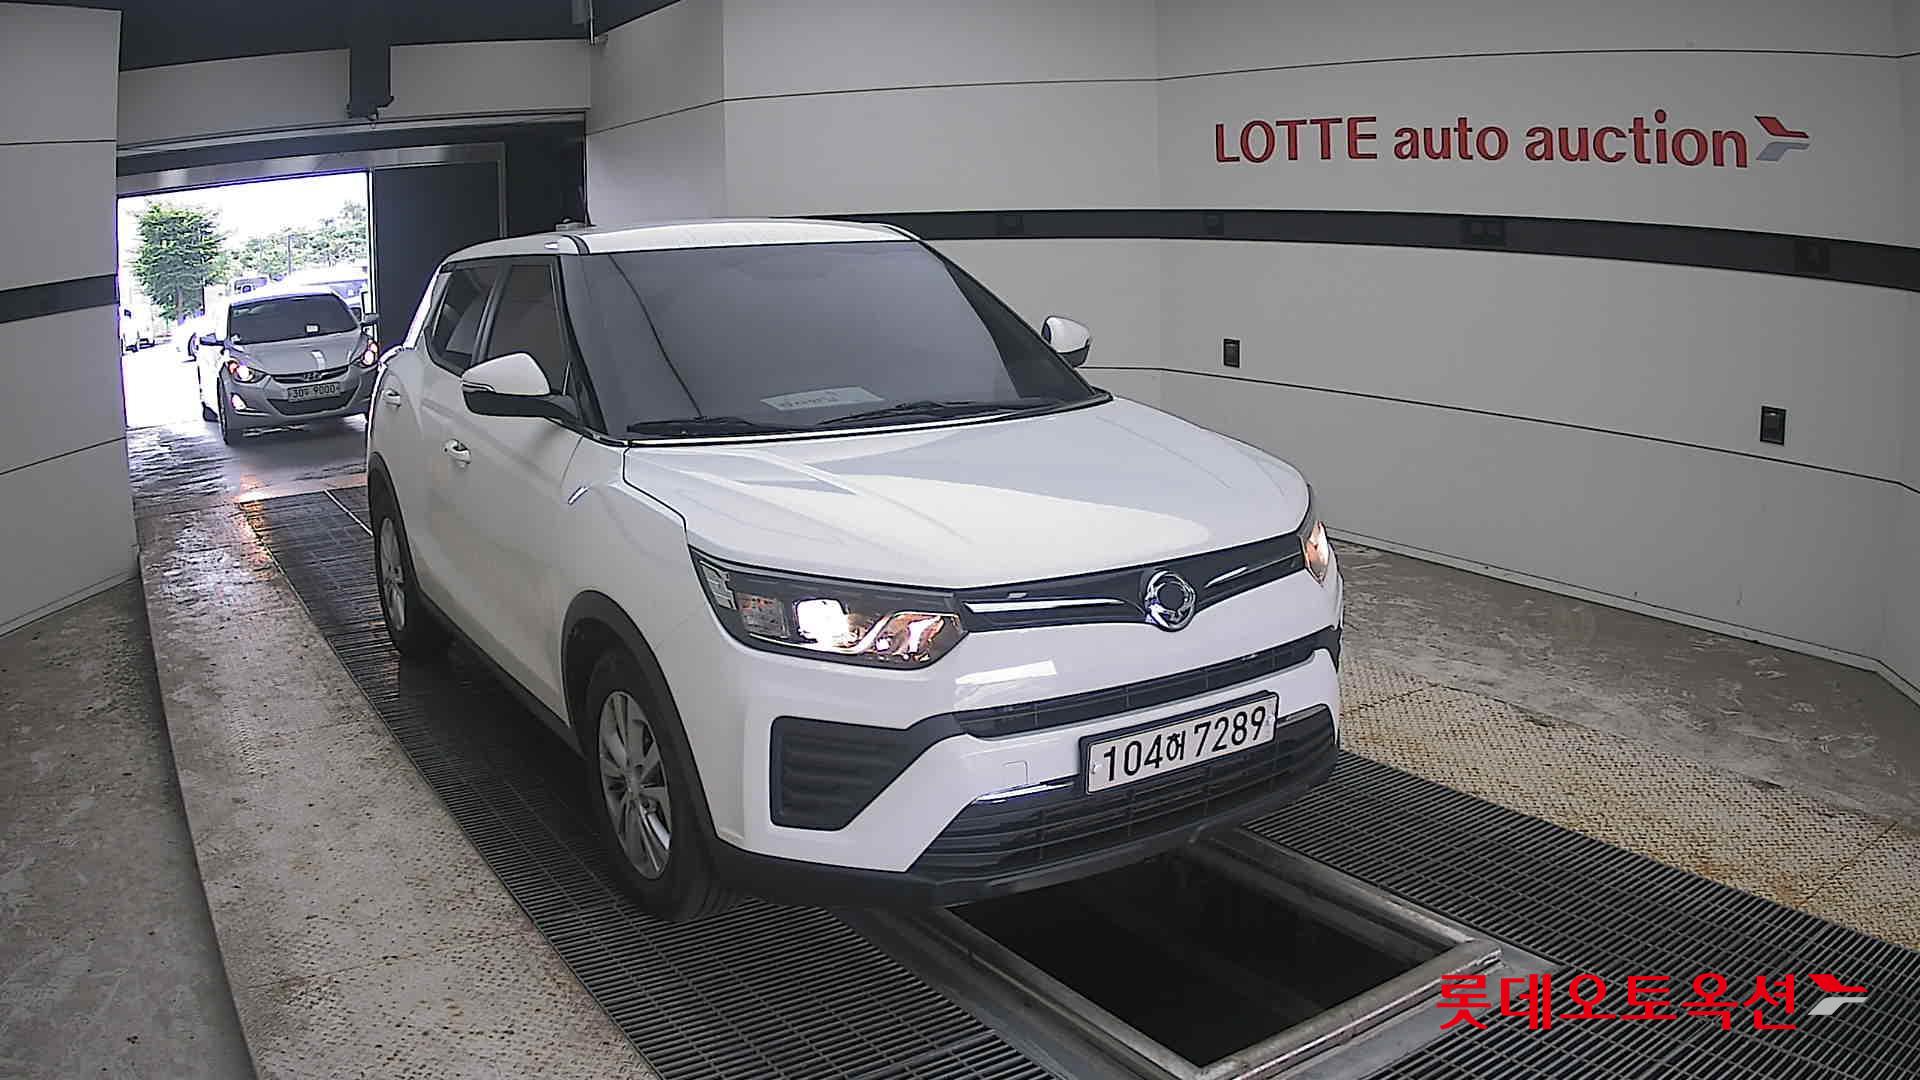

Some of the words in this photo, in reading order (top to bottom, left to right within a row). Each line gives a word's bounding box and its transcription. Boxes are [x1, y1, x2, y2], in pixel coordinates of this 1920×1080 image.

[1215, 116, 1377, 163] LOTTE
[1393, 117, 1509, 161] auto
[1525, 109, 1748, 168] auction
[1103, 730, 1186, 782] 104허
[1193, 705, 1267, 758] 7289
